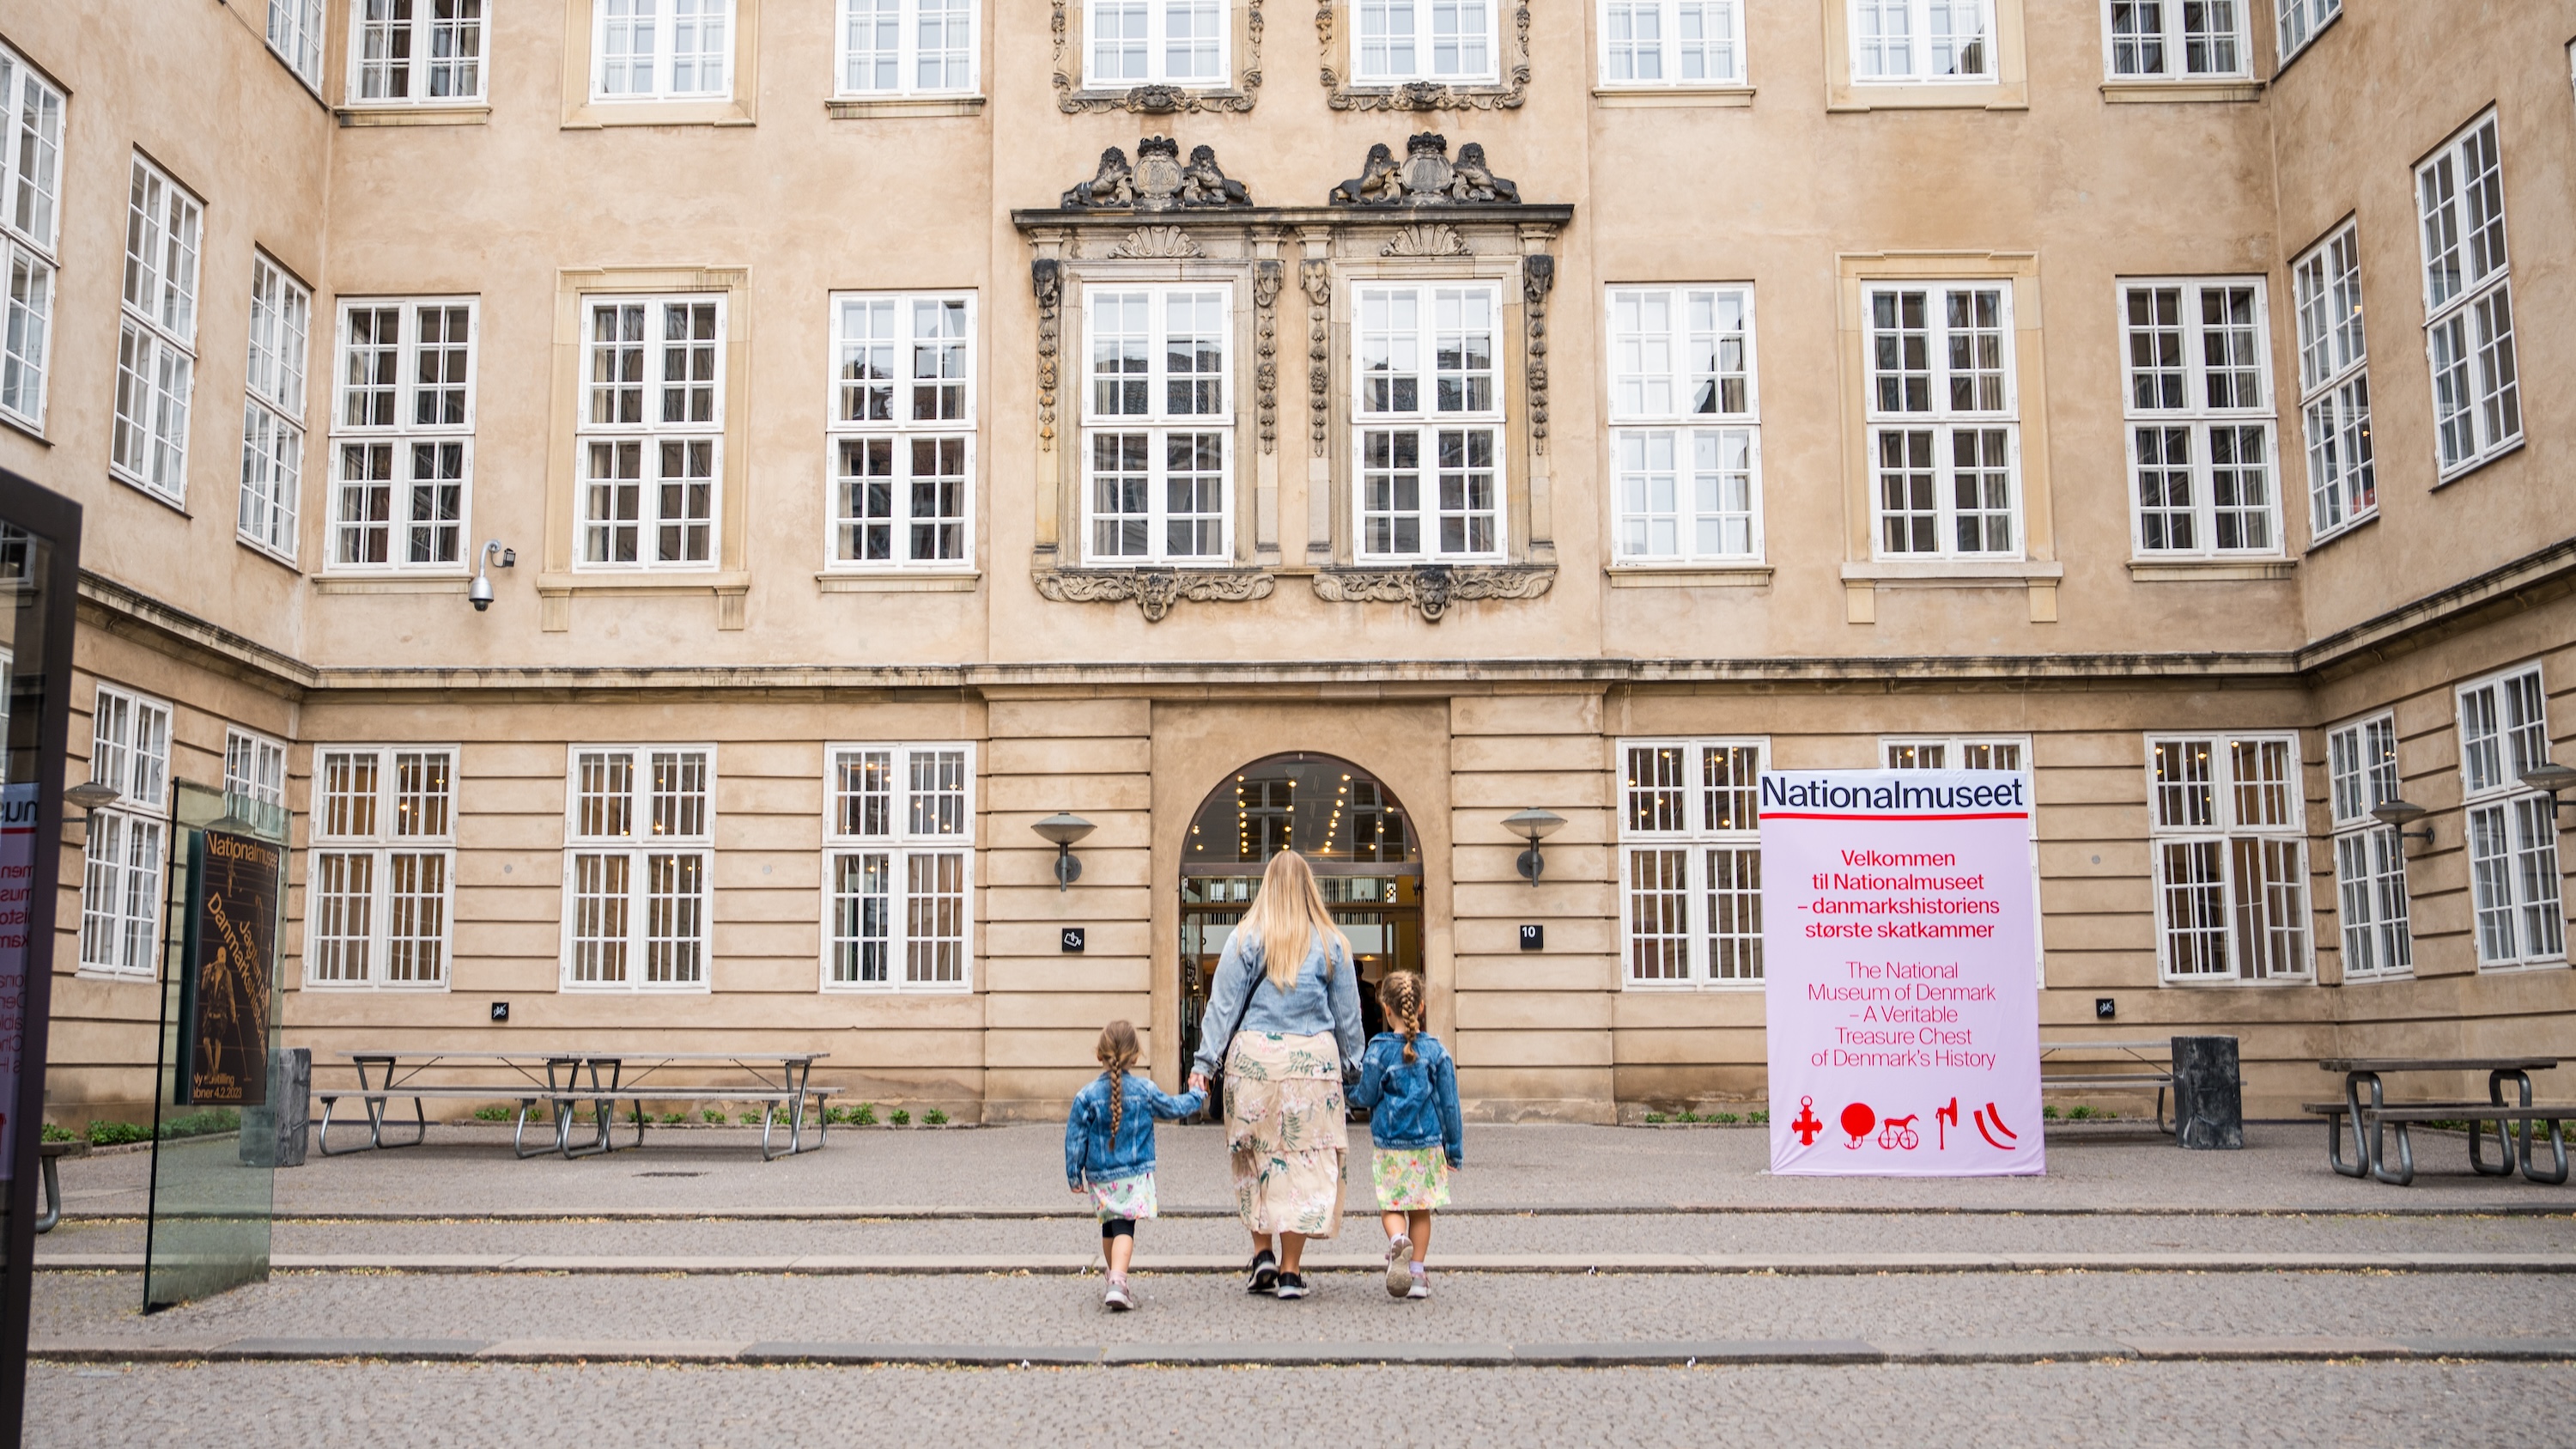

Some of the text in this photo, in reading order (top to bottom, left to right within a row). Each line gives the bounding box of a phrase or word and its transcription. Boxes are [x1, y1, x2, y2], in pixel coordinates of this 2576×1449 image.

[1761, 776, 2024, 809] Nationalmuseet
[206, 832, 277, 868] Nationalmusee
[1841, 849, 1956, 868] Velkommen
[1812, 872, 1985, 891] til Nationalmuseet
[1812, 896, 2001, 915] danmarkshistoriens
[1522, 926, 1536, 938] 10
[1805, 921, 1996, 939] største skatkammer
[1845, 961, 1959, 980] The National
[1807, 983, 1996, 1002] Museum of Denmark
[1862, 1005, 1878, 1023] A
[1881, 1004, 1959, 1023] Veritable
[1834, 1026, 1972, 1045] Treasure Chest
[1811, 1048, 1996, 1071] of Denmark’s History
[204, 1073, 234, 1087] stilling
[214, 1087, 242, 1099] 4.2.2023
